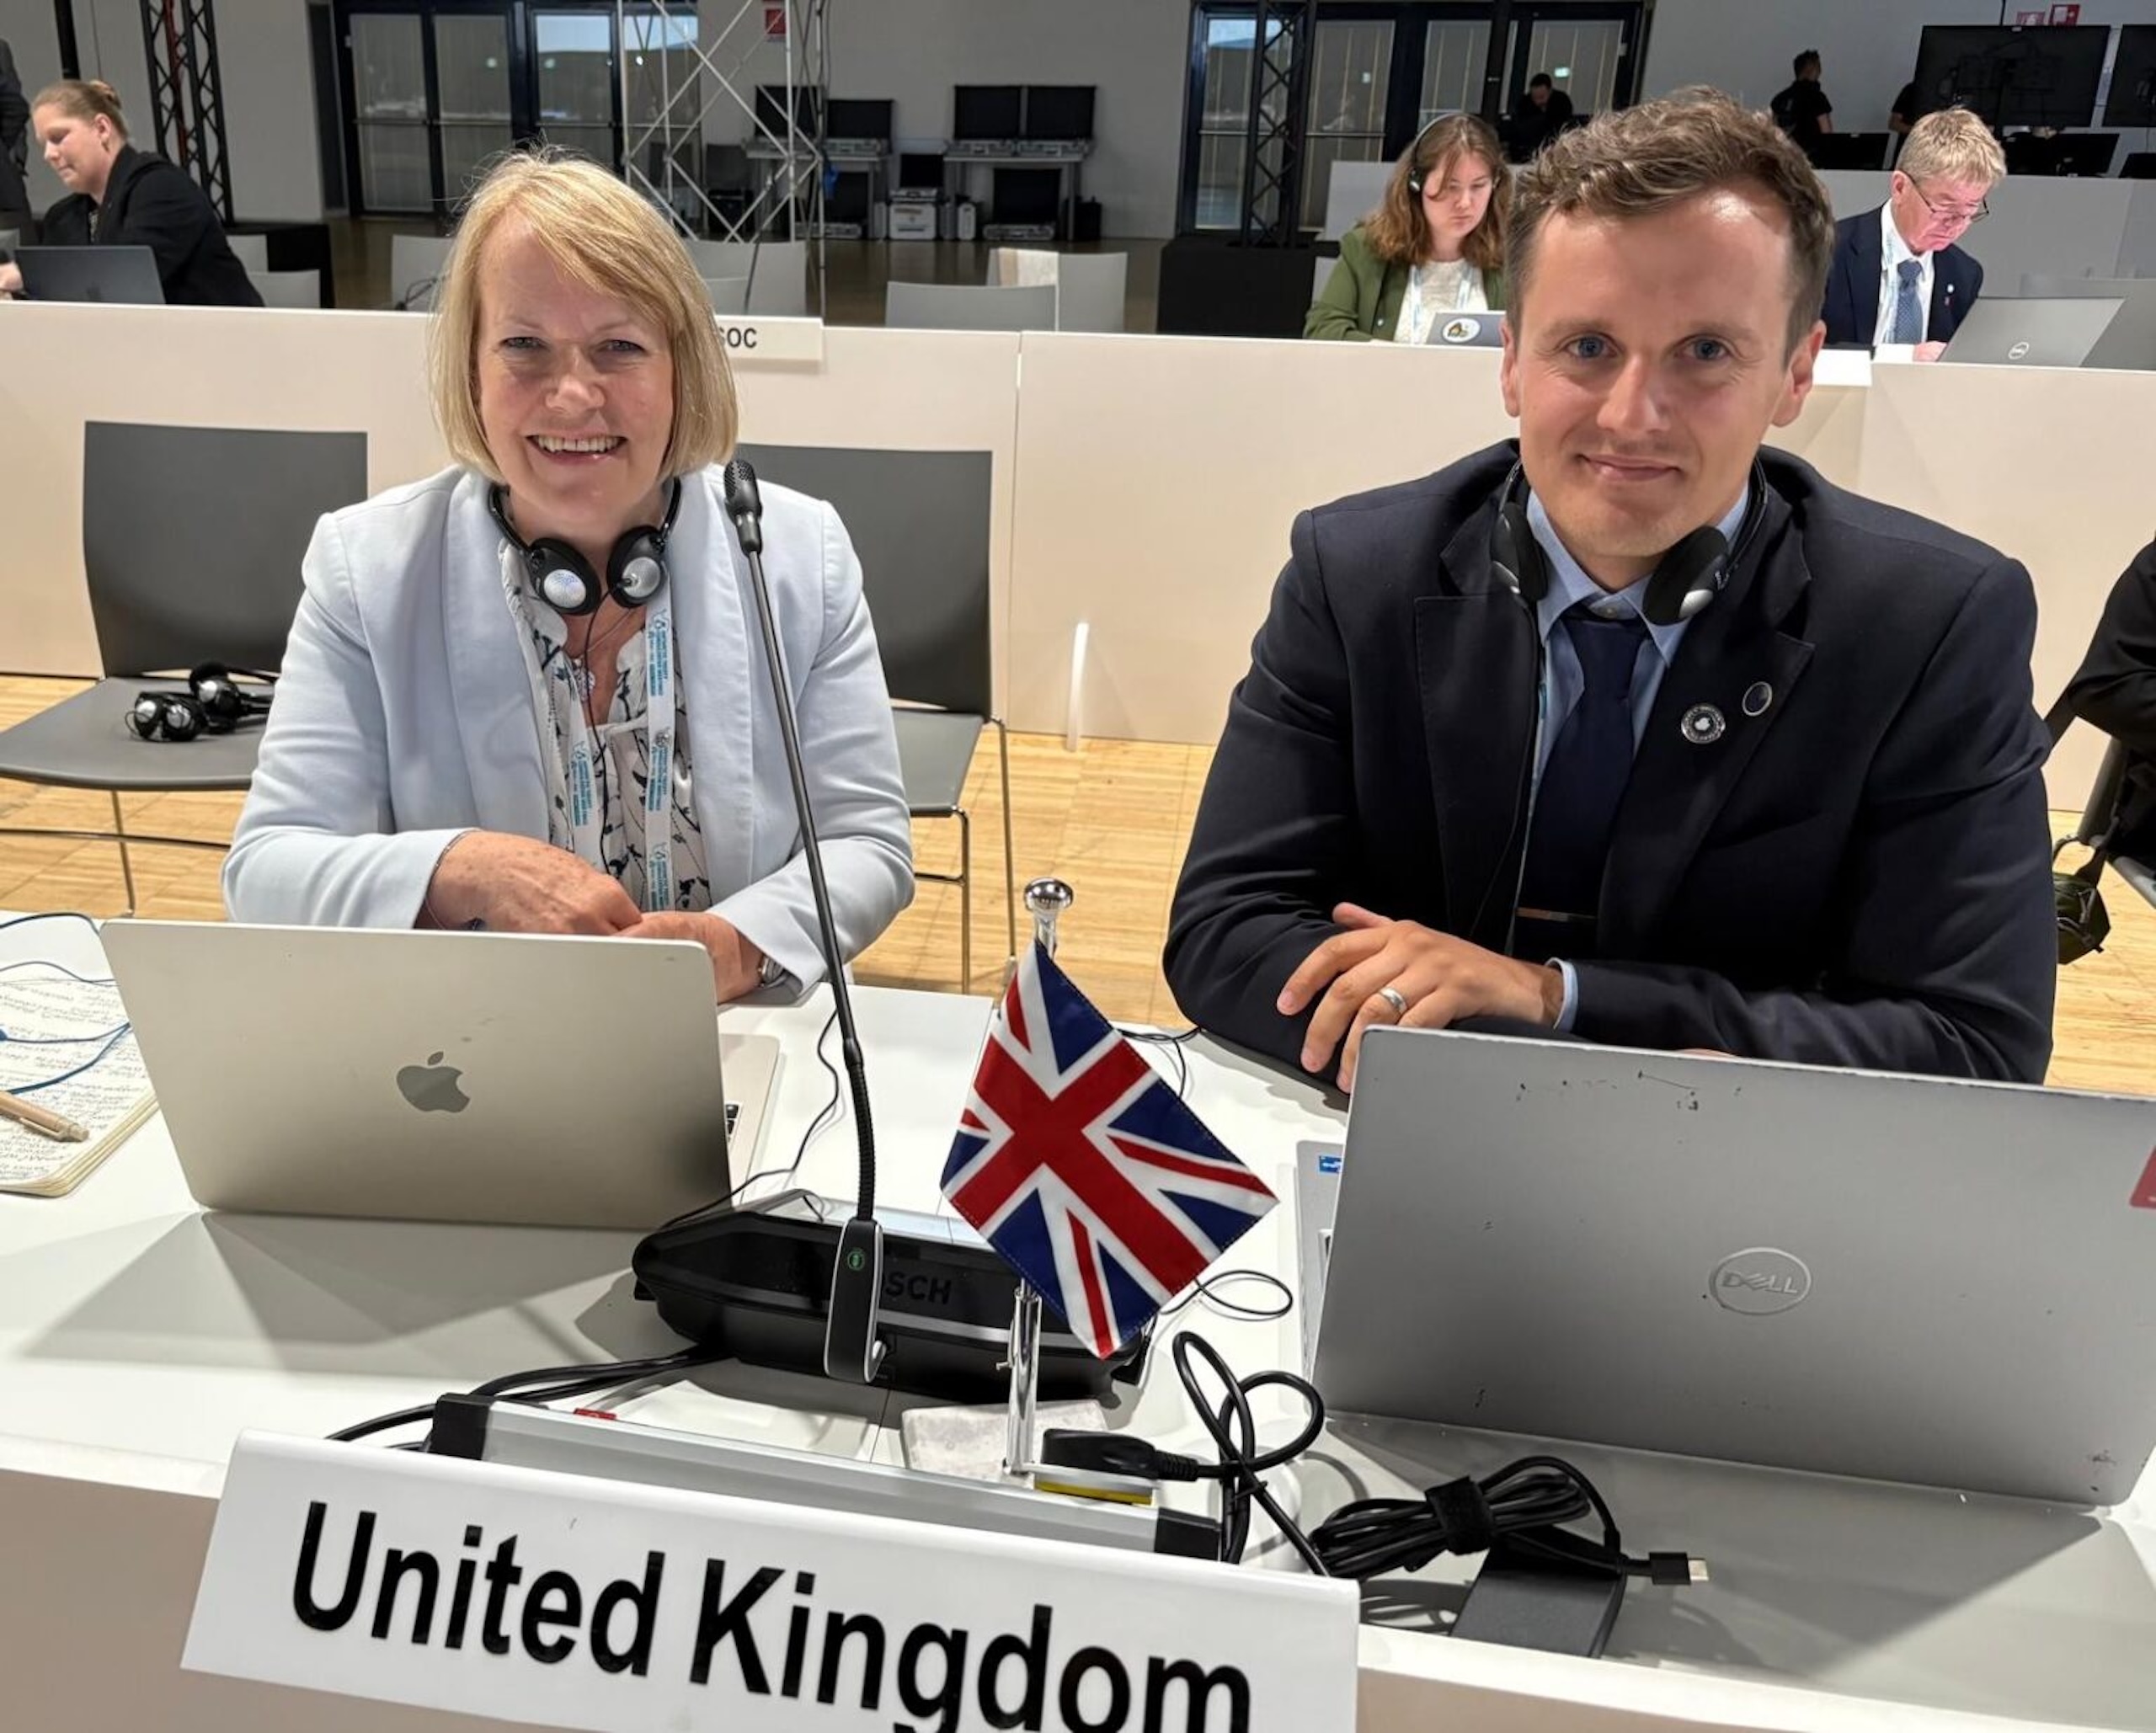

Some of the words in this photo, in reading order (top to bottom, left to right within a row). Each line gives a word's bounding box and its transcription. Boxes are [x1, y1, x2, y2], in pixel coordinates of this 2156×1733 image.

[718, 327, 757, 349] OC
[883, 1271, 953, 1305] SCH
[1721, 1270, 1798, 1294] DELL
[293, 1501, 666, 1678] United
[689, 1558, 1251, 1733] Kingdom
